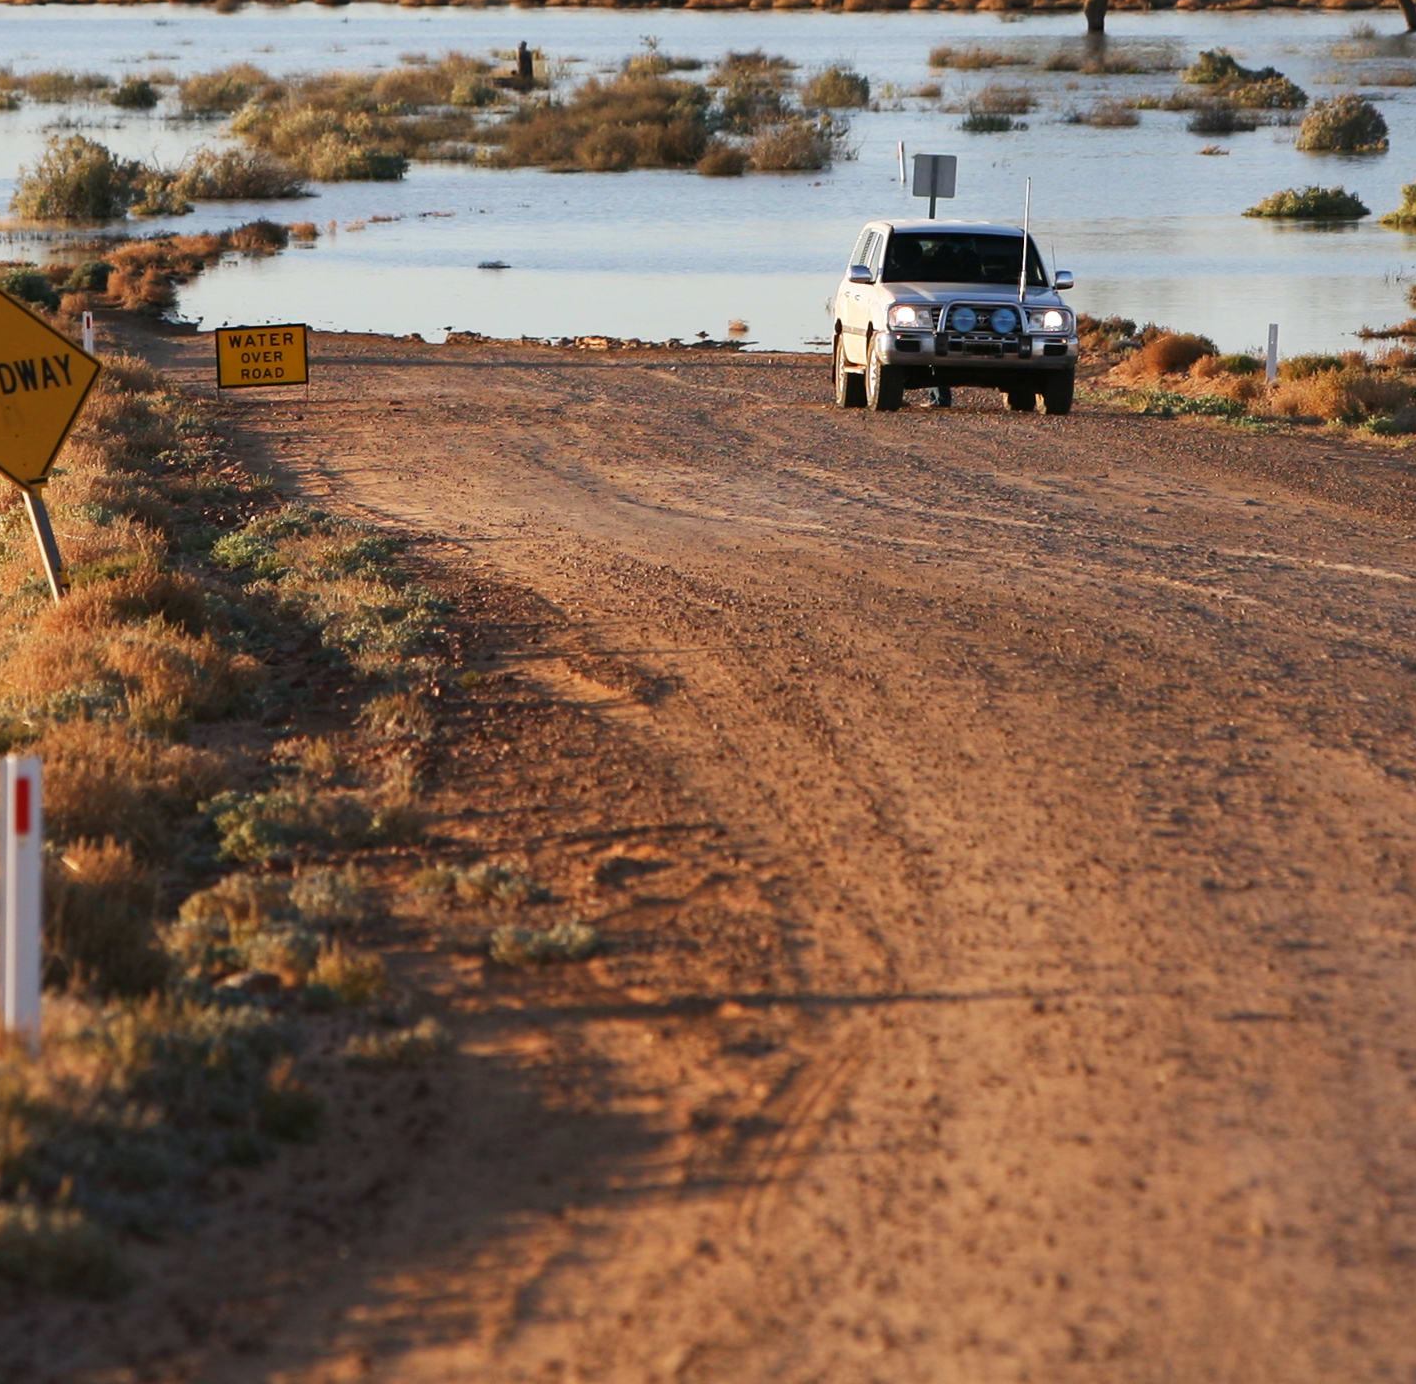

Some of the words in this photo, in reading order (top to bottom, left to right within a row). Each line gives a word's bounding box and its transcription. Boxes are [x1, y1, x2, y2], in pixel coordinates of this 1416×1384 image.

[228, 332, 294, 348] WATER
[241, 351, 283, 364] OVER
[241, 367, 285, 379] ROAD
